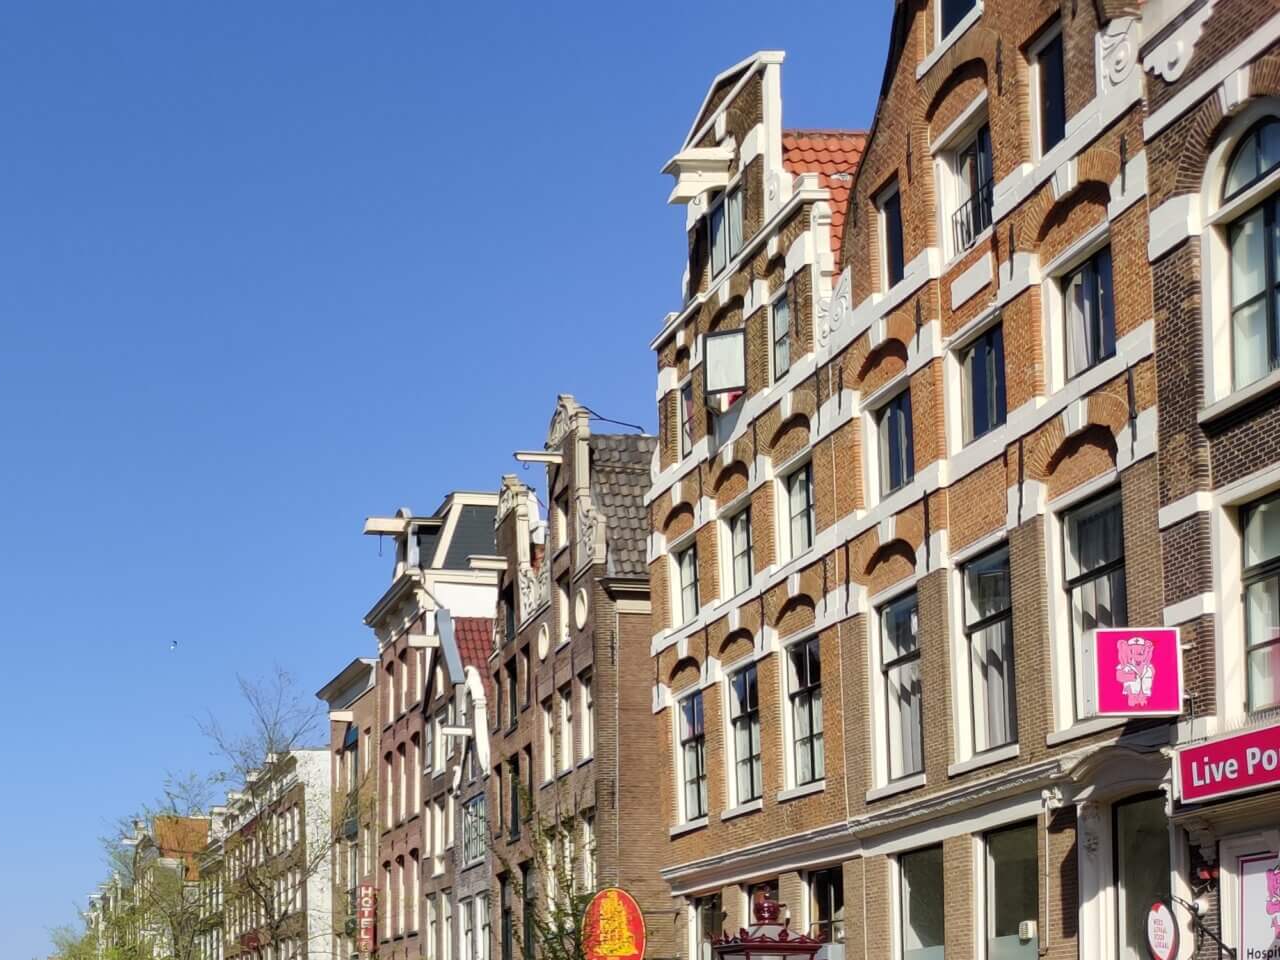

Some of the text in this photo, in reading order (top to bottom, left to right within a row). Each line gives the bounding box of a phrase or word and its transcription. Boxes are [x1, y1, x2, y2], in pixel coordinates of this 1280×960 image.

[1191, 747, 1280, 787] Live Po
[361, 886, 373, 939] HOTEL
